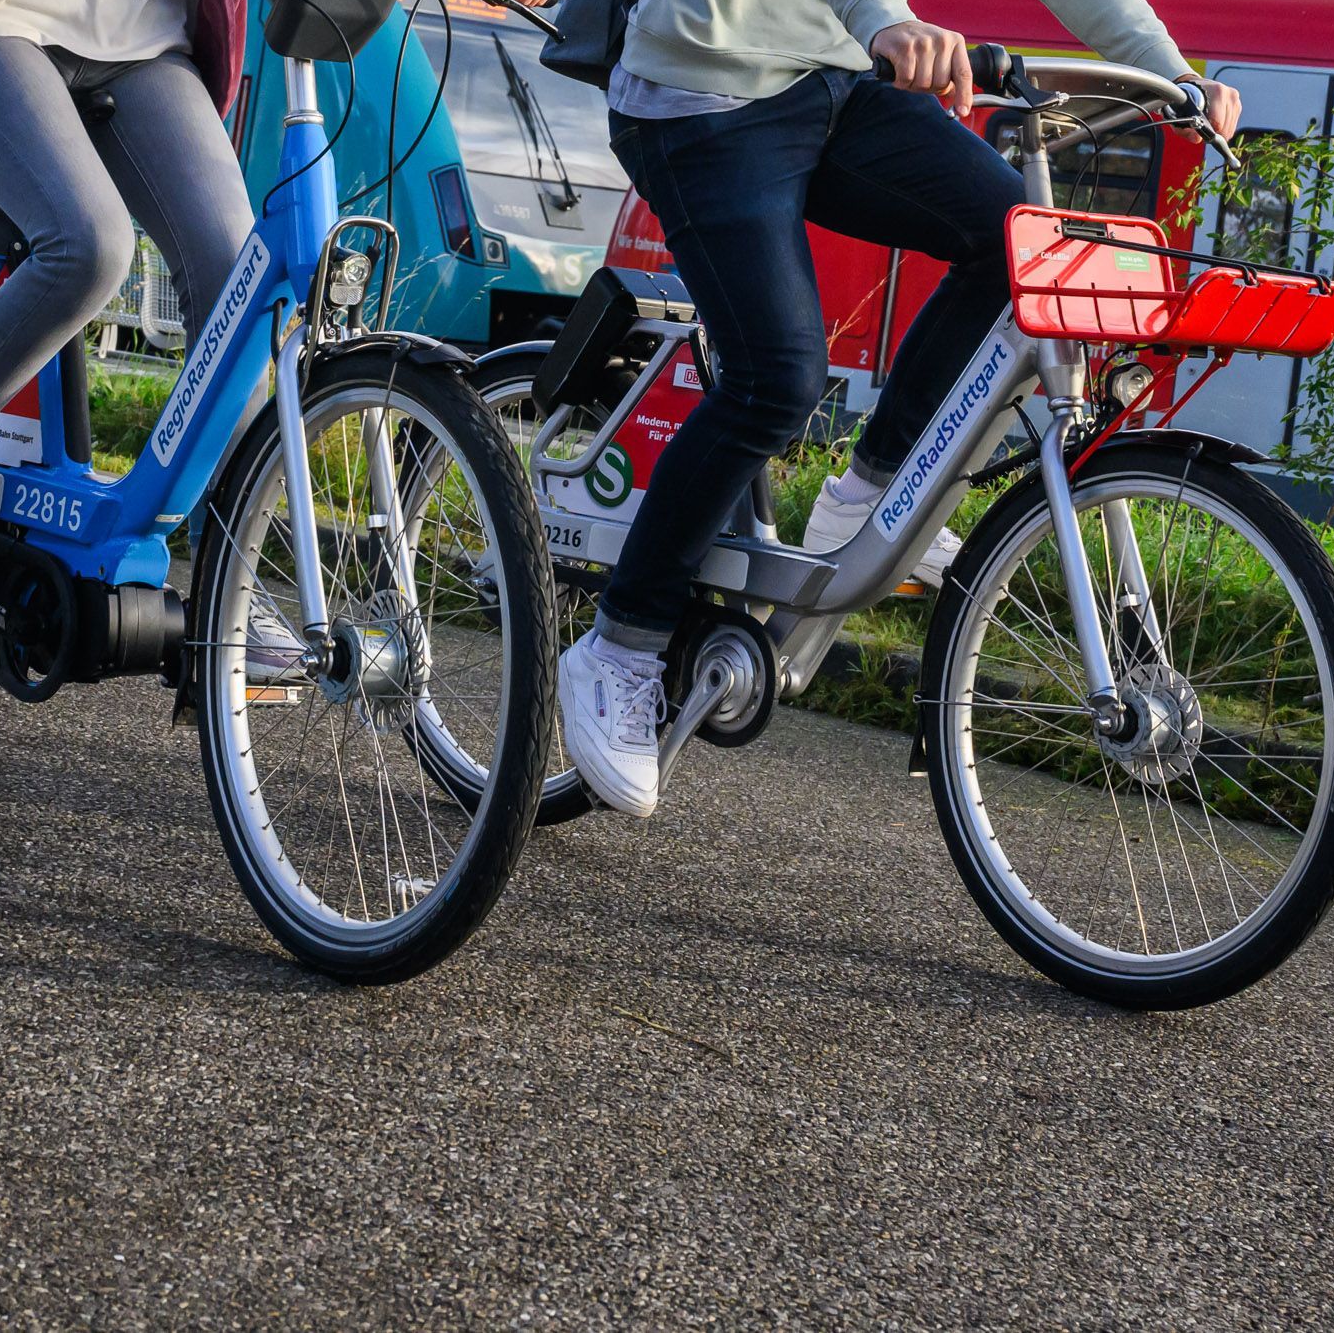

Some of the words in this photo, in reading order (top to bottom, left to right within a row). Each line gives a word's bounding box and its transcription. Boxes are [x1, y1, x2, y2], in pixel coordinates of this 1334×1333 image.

[157, 245, 263, 454] RegioRadStuttgart
[859, 350, 869, 365] 2
[636, 415, 672, 430] Modern,
[649, 430, 664, 441] Für
[881, 343, 1007, 531] RegioRadStuttgart
[593, 446, 626, 499] S
[13, 484, 82, 531] 22815
